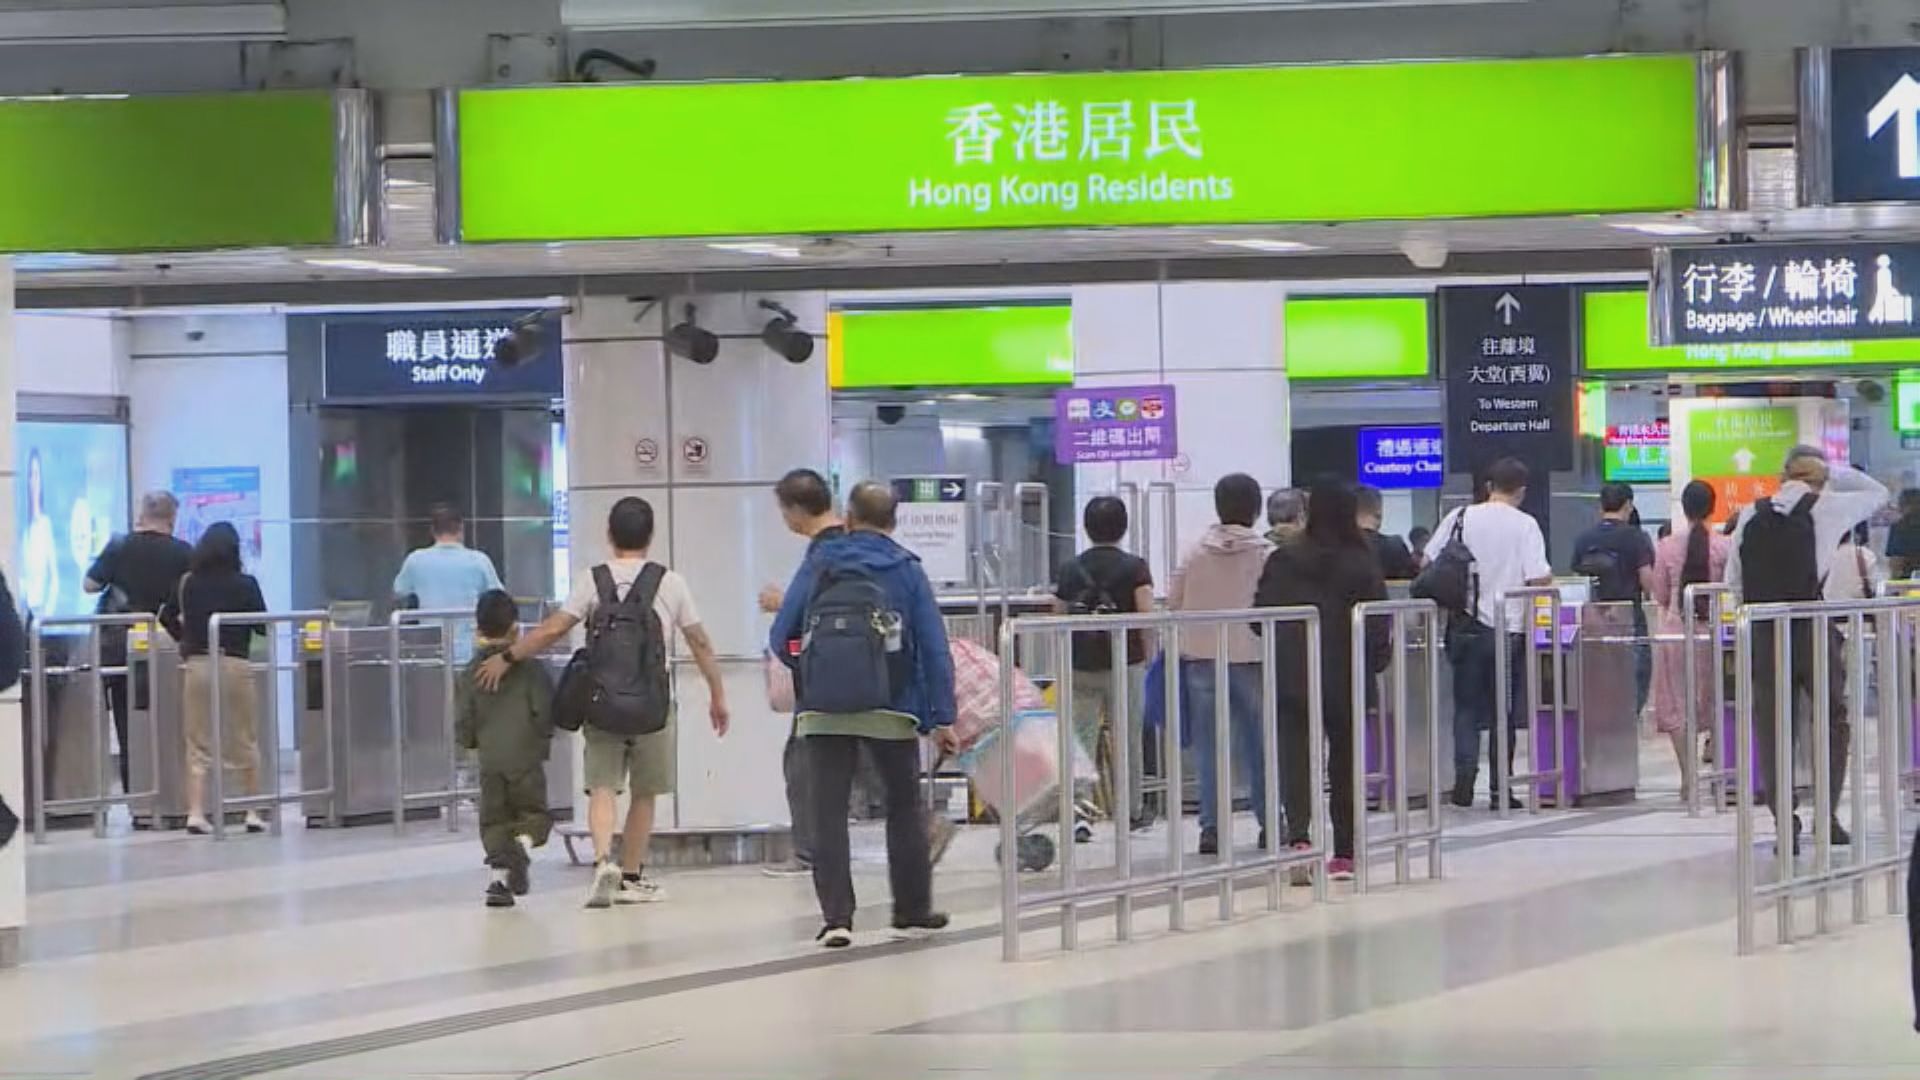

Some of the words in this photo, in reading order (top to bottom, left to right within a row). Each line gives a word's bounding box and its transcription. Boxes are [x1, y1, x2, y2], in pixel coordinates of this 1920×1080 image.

[944, 98, 1204, 165] 香港居民
[908, 177, 992, 213] Hong
[999, 174, 1079, 212] Kong
[1087, 172, 1235, 204] Residents
[1682, 262, 1756, 305] 行李
[1783, 257, 1858, 302] 輪椅
[1686, 308, 1756, 334] Baggage
[1768, 303, 1859, 329] Wheelchair
[412, 365, 448, 383] Staff
[450, 365, 486, 384] Only
[1477, 398, 1492, 410] To
[1493, 398, 1538, 411] Western
[1470, 419, 1527, 433] Departure
[1528, 417, 1551, 431] Hall
